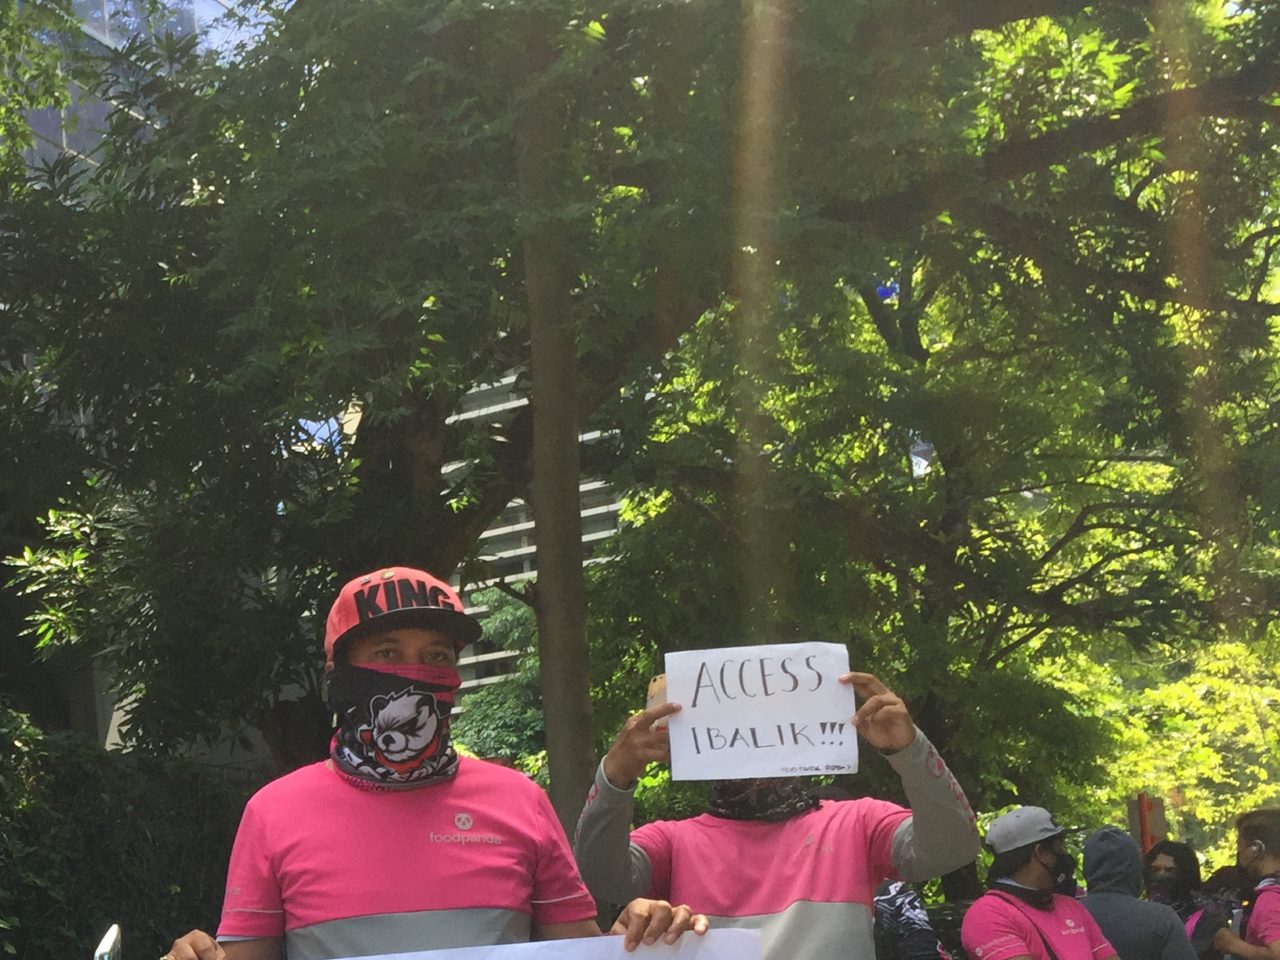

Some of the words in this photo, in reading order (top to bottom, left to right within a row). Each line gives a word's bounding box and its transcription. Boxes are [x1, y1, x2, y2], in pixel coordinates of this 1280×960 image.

[353, 579, 455, 623] KING
[692, 655, 823, 708] ACCESS
[429, 832, 501, 846] foodpanda
